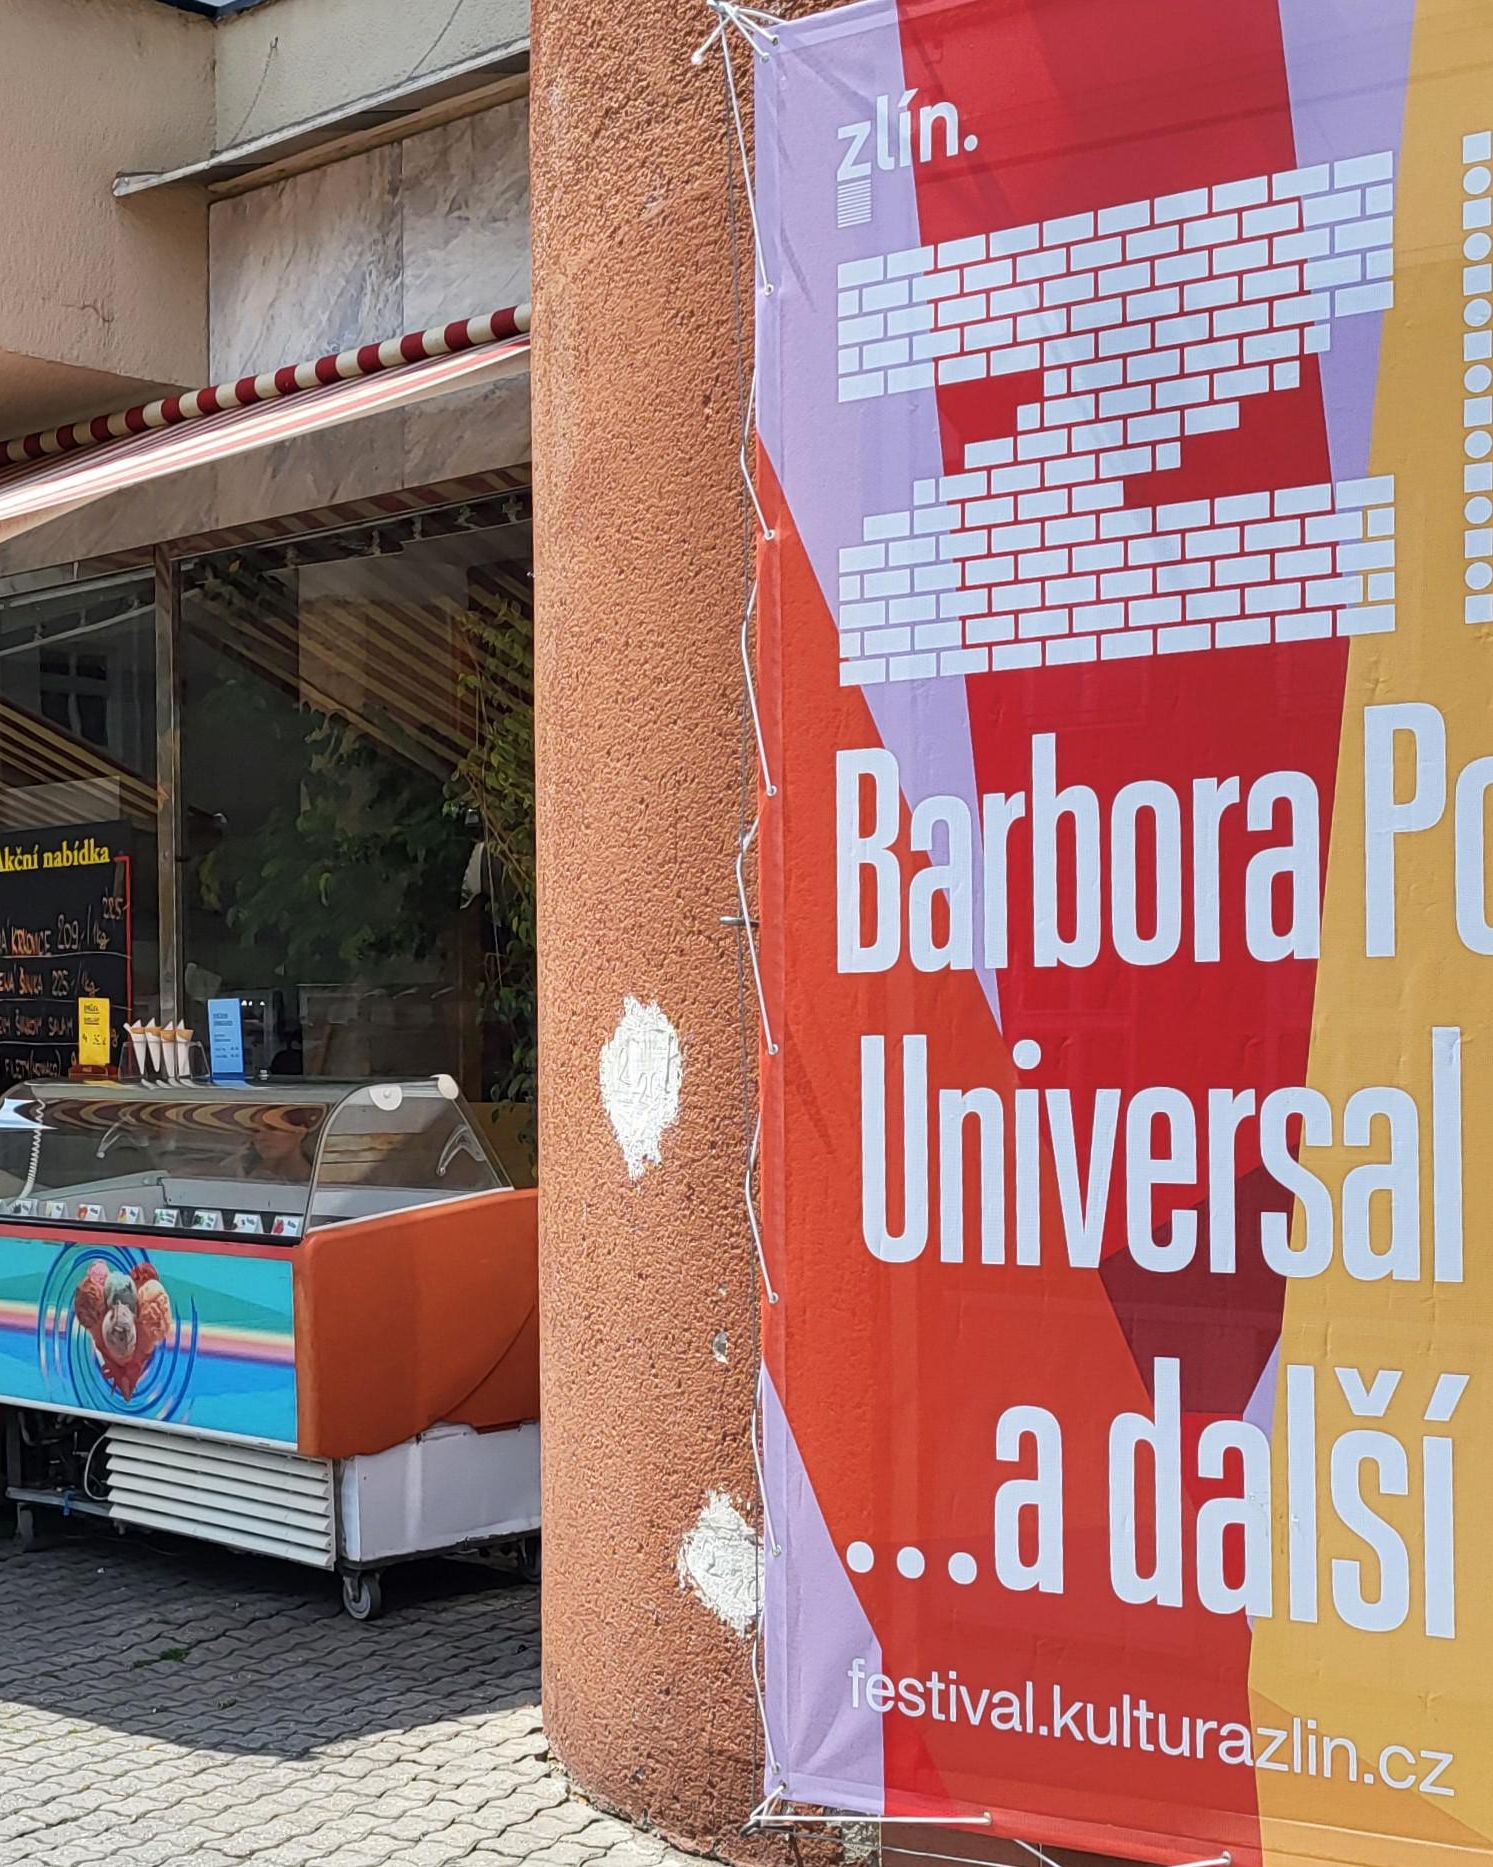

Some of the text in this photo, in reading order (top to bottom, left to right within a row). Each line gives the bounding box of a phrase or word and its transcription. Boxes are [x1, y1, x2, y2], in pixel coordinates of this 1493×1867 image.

[837, 88, 979, 183] zlín.
[43, 837, 110, 869] nabídka
[836, 732, 1321, 974] Barbora
[860, 1026, 1464, 1284] Universal
[1108, 1356, 1470, 1640] další
[846, 1657, 1455, 1798] festival.kulturazlin.cz
